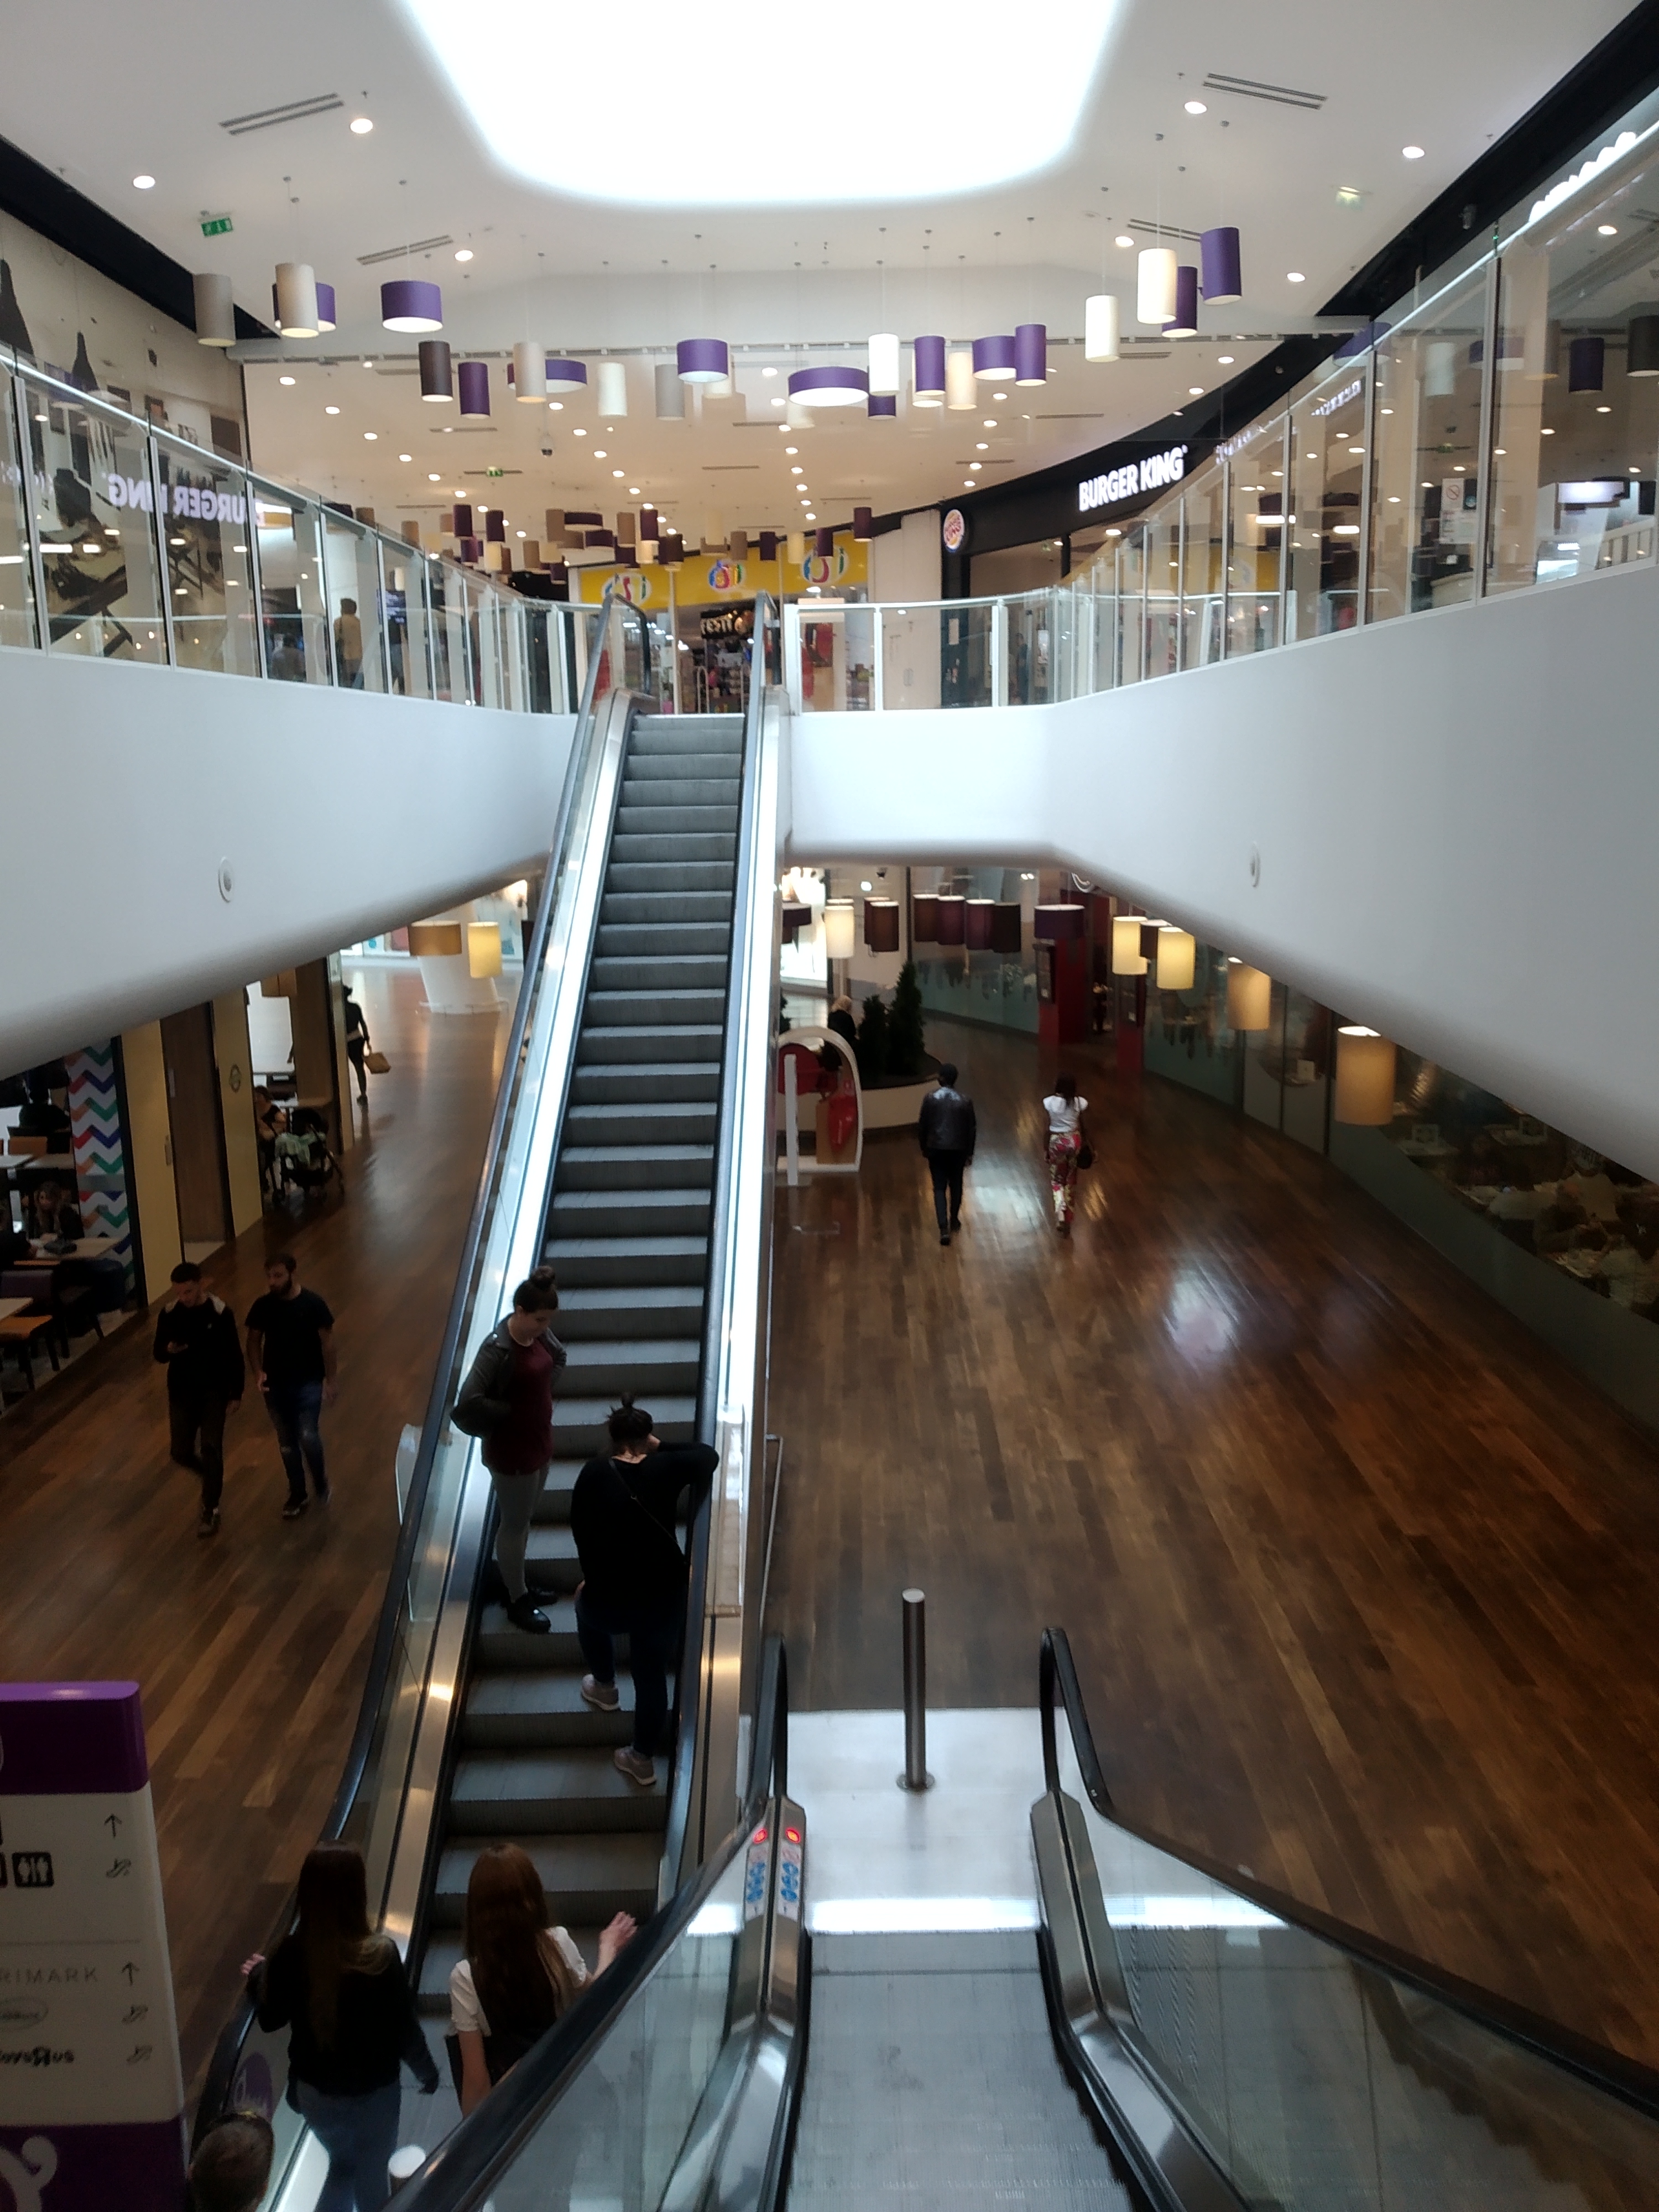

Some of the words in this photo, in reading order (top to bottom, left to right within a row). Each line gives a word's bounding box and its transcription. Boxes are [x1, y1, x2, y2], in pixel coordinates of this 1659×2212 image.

[1078, 464, 1139, 512] BURGER
[1140, 447, 1184, 492] KING
[0, 1967, 97, 1983] RIMARK
